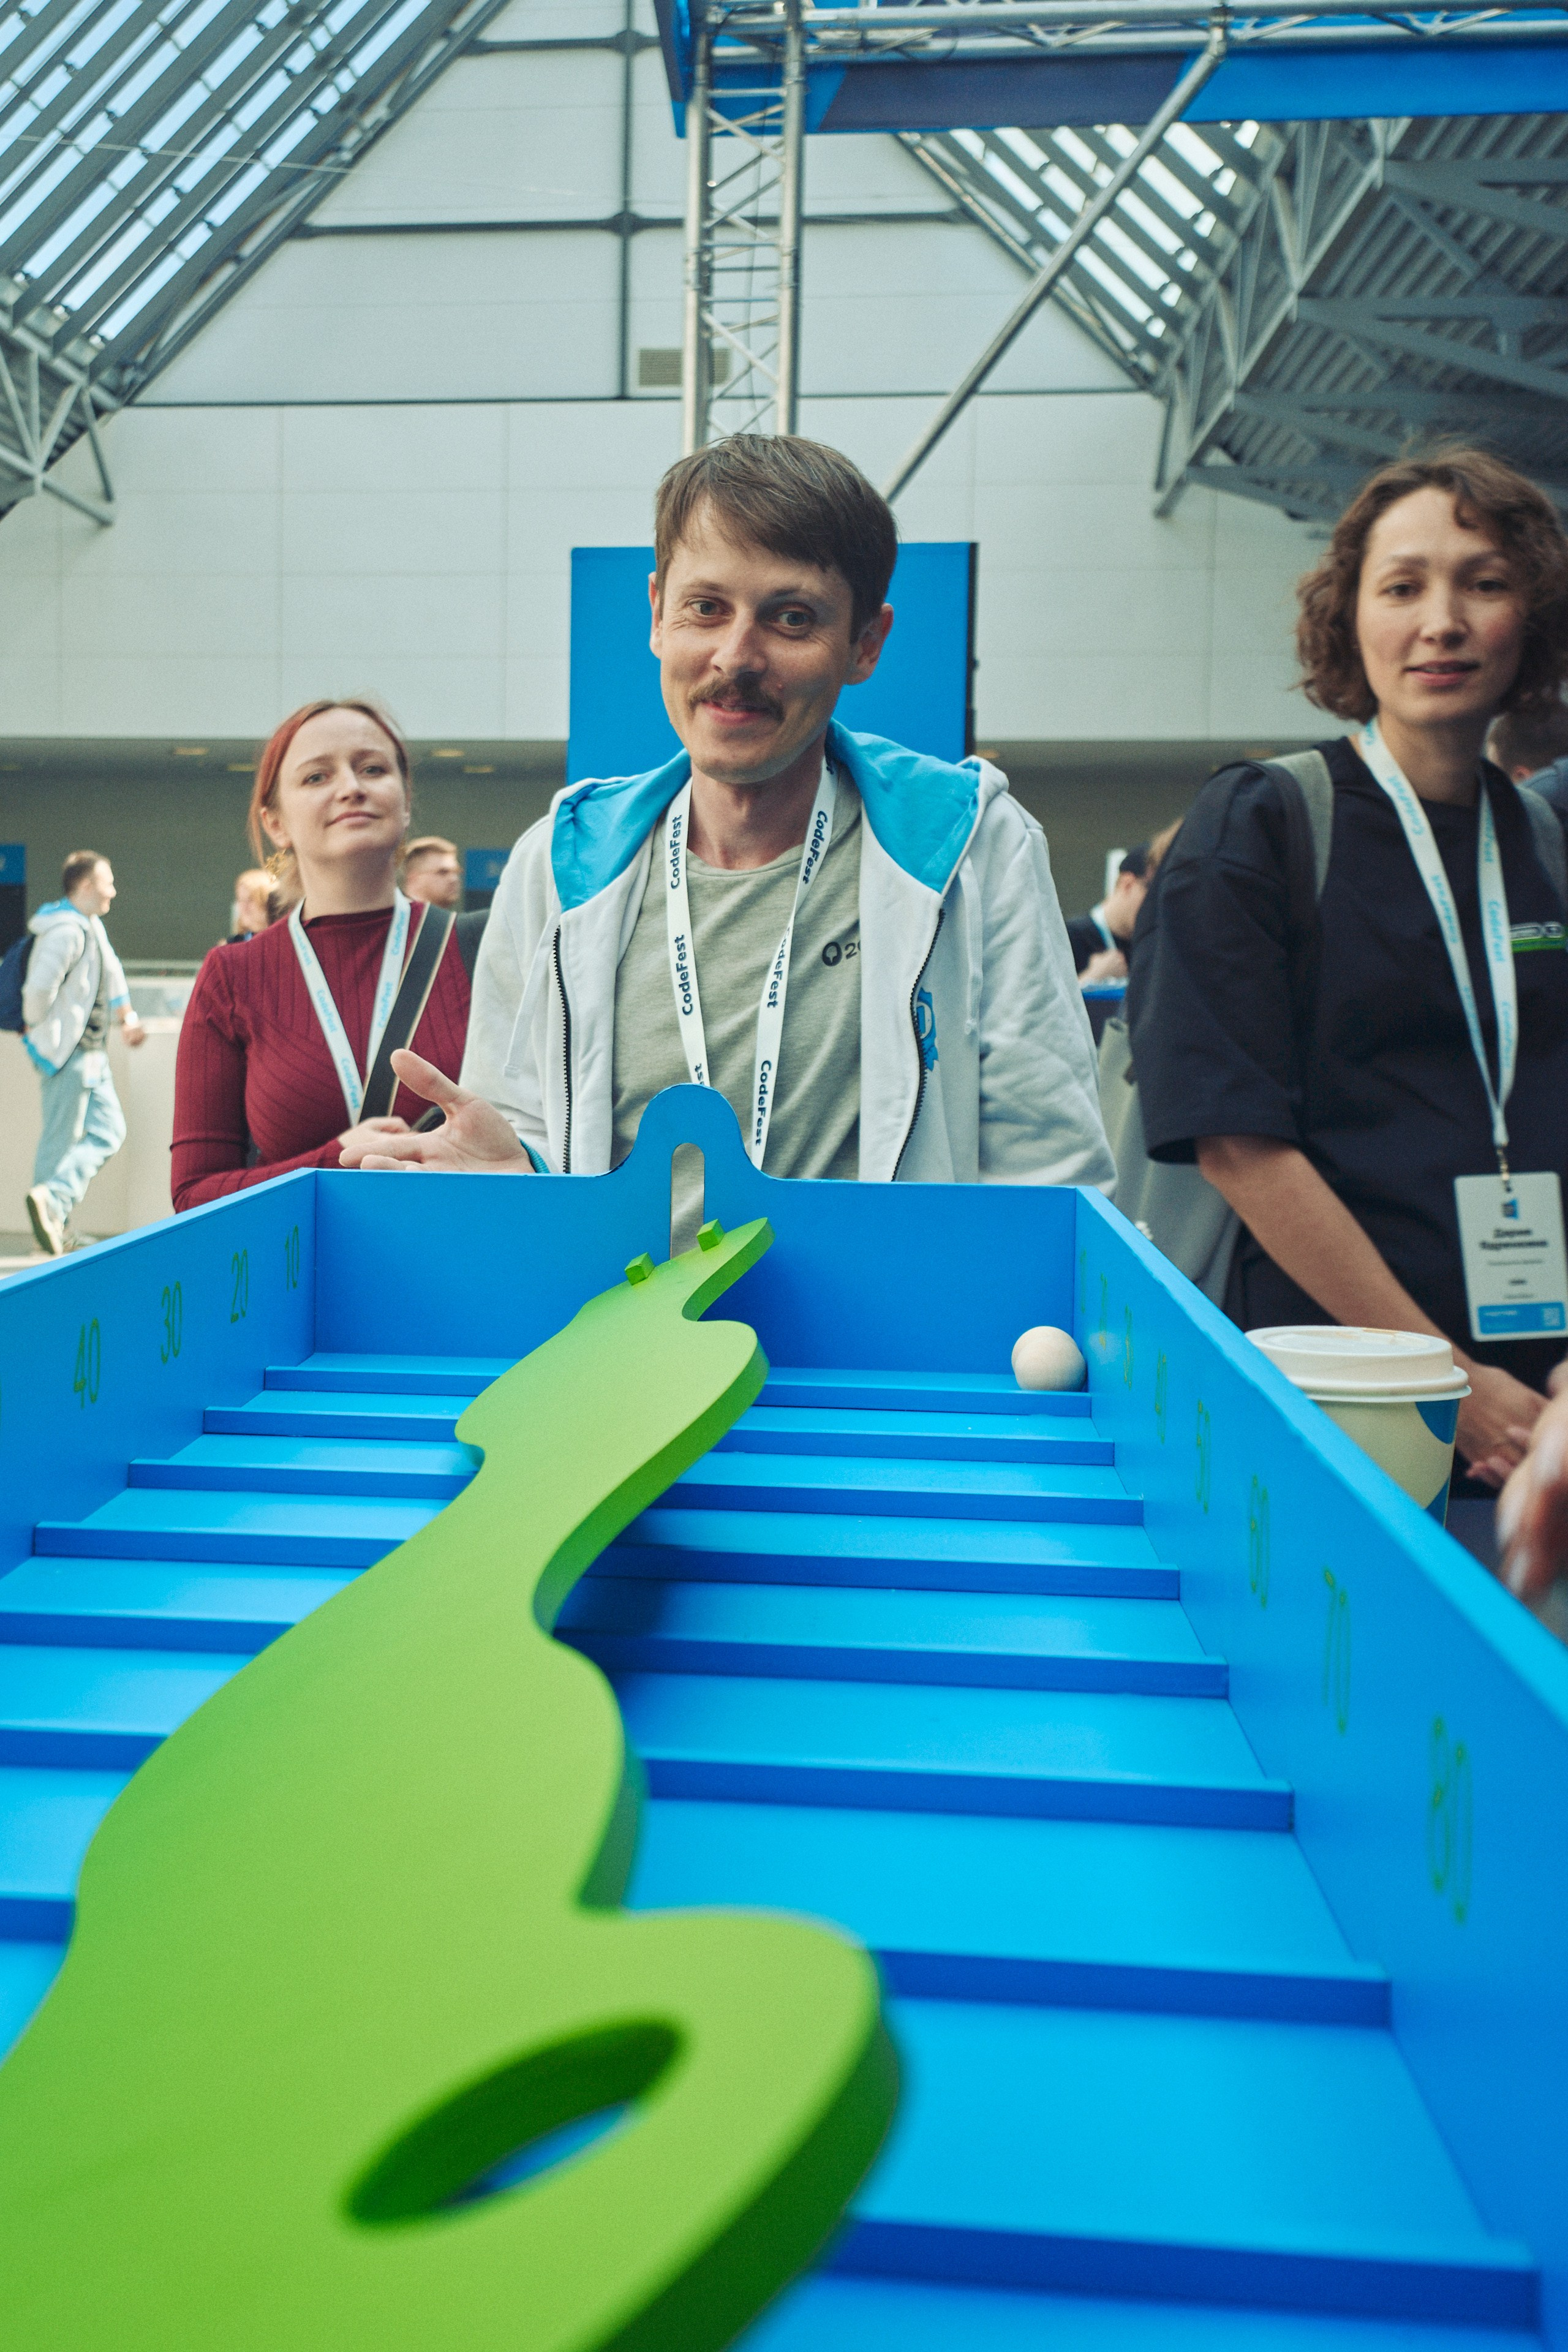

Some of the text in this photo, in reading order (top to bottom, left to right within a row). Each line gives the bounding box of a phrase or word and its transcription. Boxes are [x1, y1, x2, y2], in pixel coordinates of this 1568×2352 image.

[670, 815, 682, 889] CodeFest
[802, 810, 828, 884] CodeFest
[674, 934, 693, 1016] CodeFest
[767, 927, 790, 1008] CodeFest
[755, 1060, 772, 1146] CodeFest
[230, 1248, 249, 1324] 20
[285, 1224, 300, 1292] 10
[74, 1317, 101, 1410] 40
[160, 1280, 182, 1365] 30
[1322, 1565, 1351, 1735] 70
[1426, 1713, 1472, 1924] 80
